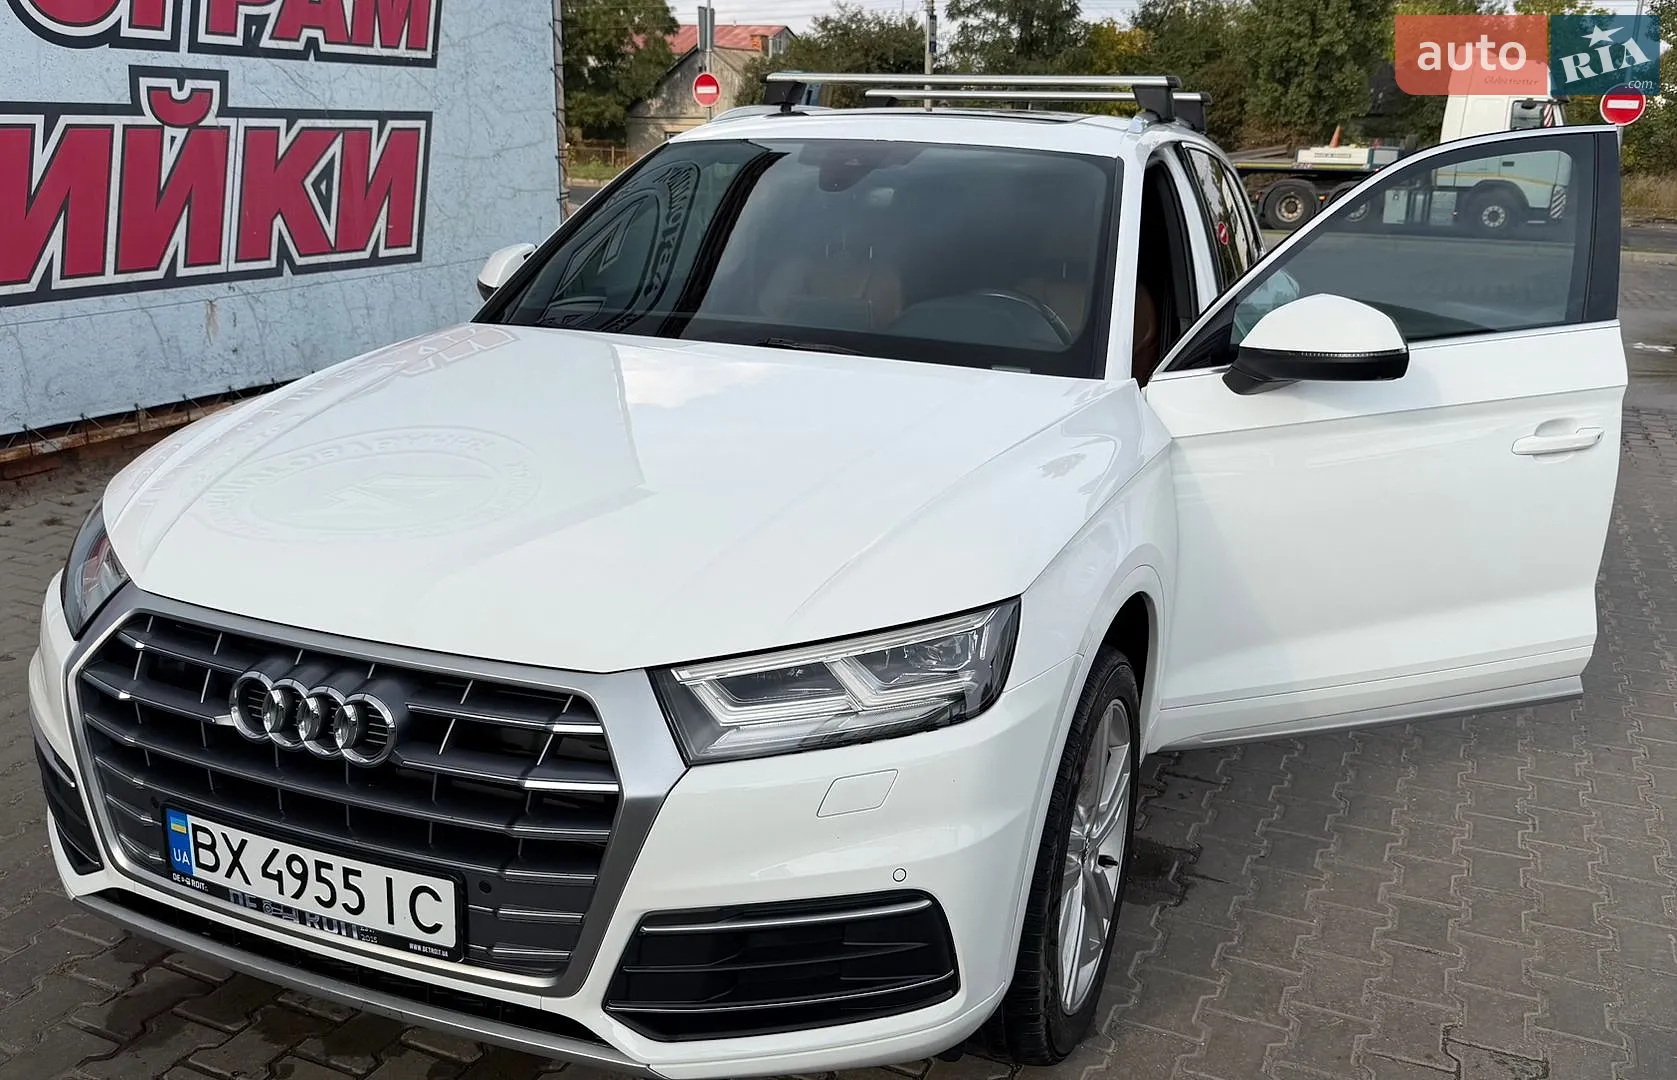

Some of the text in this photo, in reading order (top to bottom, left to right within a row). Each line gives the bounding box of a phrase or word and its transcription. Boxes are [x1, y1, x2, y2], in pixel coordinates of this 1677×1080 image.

[1484, 75, 1539, 86] Globetrotter
[173, 847, 191, 866] UA
[191, 823, 443, 935] BX 4955 IC
